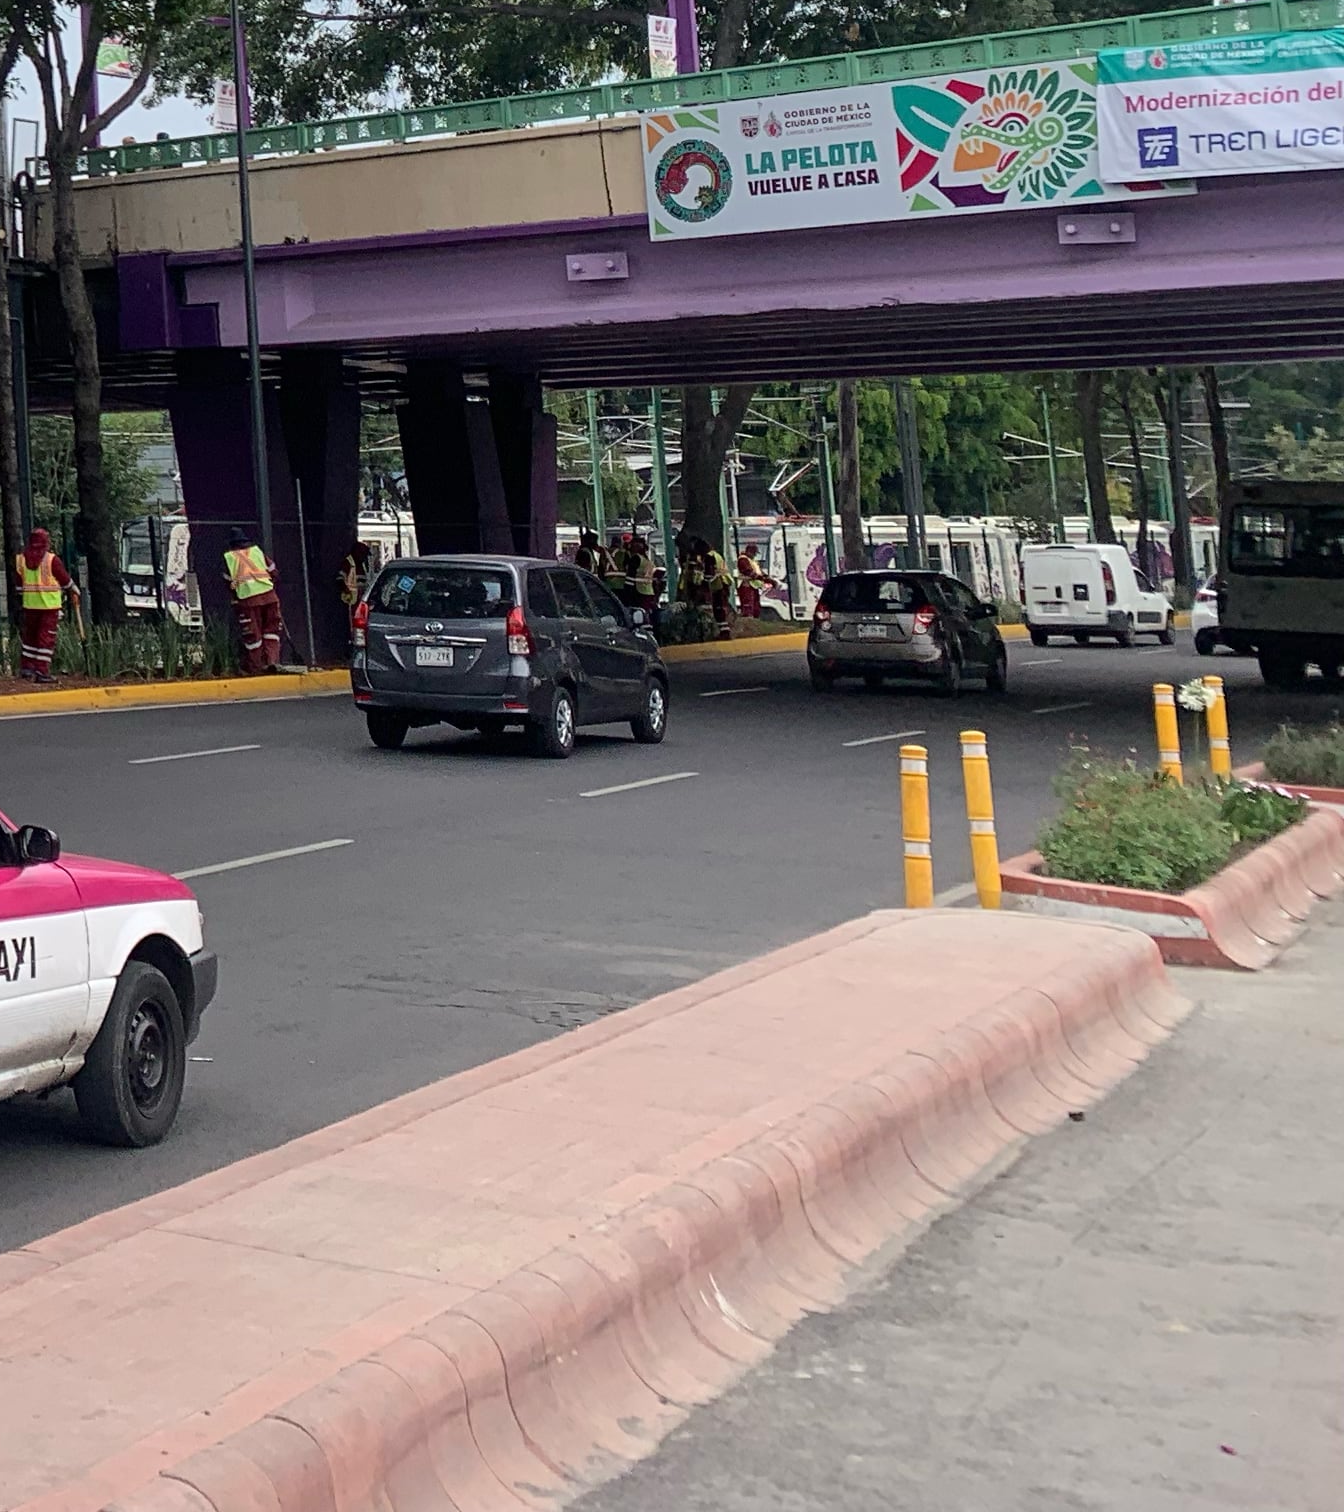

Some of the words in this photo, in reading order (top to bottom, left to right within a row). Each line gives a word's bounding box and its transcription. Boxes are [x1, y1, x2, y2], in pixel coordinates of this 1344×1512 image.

[784, 106, 837, 119] GOBIERNO
[840, 104, 854, 112] DE
[857, 102, 870, 110] LA
[1124, 85, 1300, 114] Modernización
[1308, 79, 1343, 102] del
[784, 118, 819, 128] CIUDAD
[1189, 130, 1266, 154] TREN
[1275, 125, 1344, 149] LIGE
[745, 151, 776, 175] LA
[781, 140, 878, 171] PELOTA
[748, 173, 813, 196] VUELVE
[817, 172, 830, 189] A
[834, 168, 880, 187] CASA
